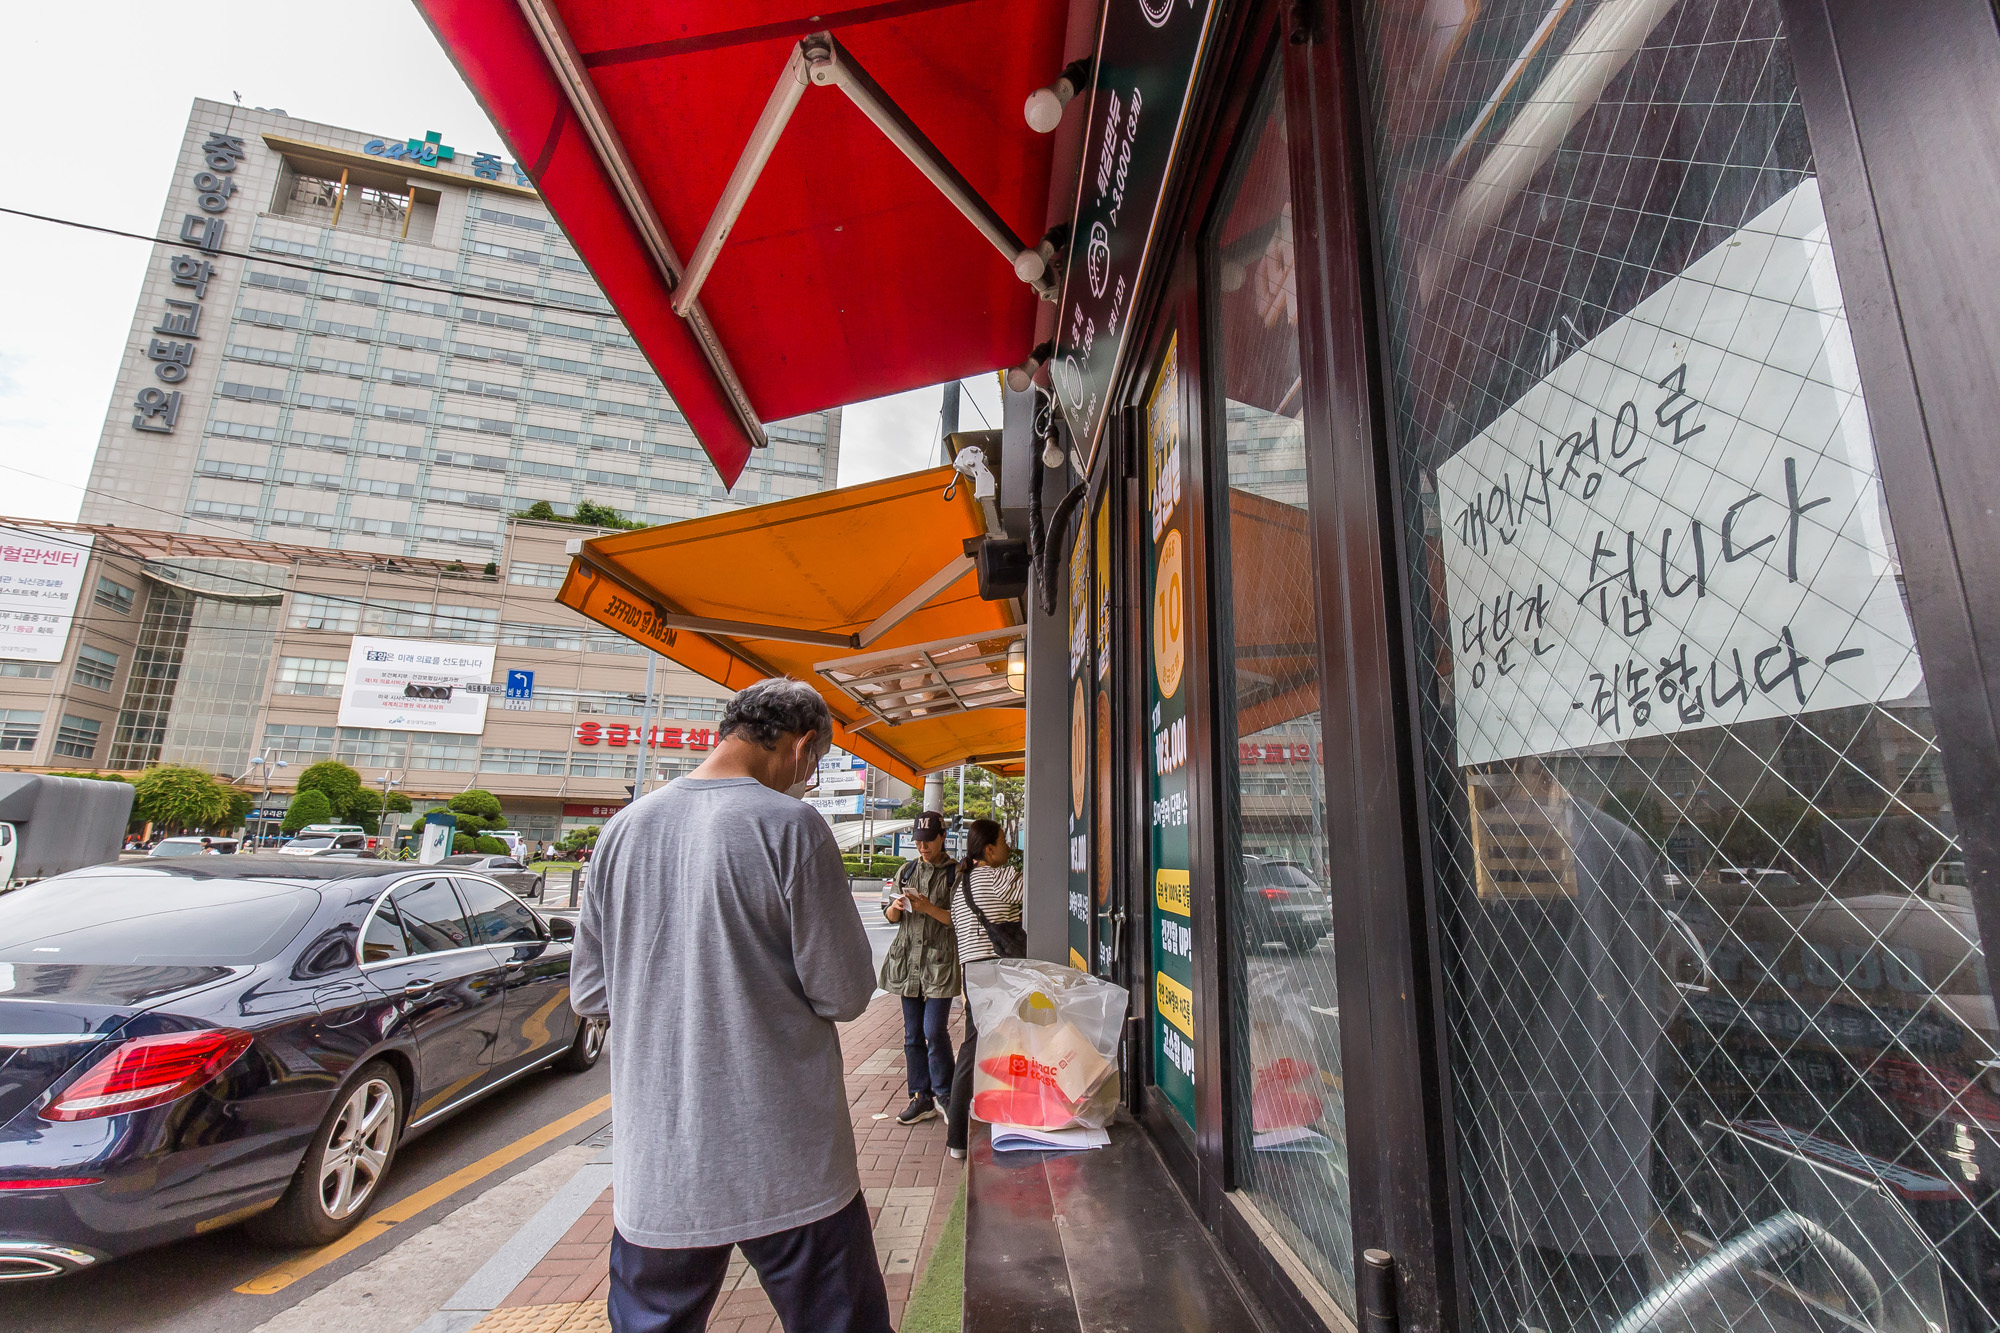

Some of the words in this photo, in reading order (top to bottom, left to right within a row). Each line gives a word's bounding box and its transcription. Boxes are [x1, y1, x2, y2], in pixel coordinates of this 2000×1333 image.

[1098, 89, 1121, 198] 튀김만두
[132, 131, 245, 435] 중앙대학교병원
[0, 545, 79, 567] 혈관센터
[41, 591, 69, 600] 시스템
[1159, 571, 1181, 655] 10
[398, 653, 414, 663] 미래
[443, 657, 482, 667] 선도합니다
[577, 722, 719, 750] 응급의료센
[592, 807, 621, 815] 응급의
[918, 818, 930, 829] M
